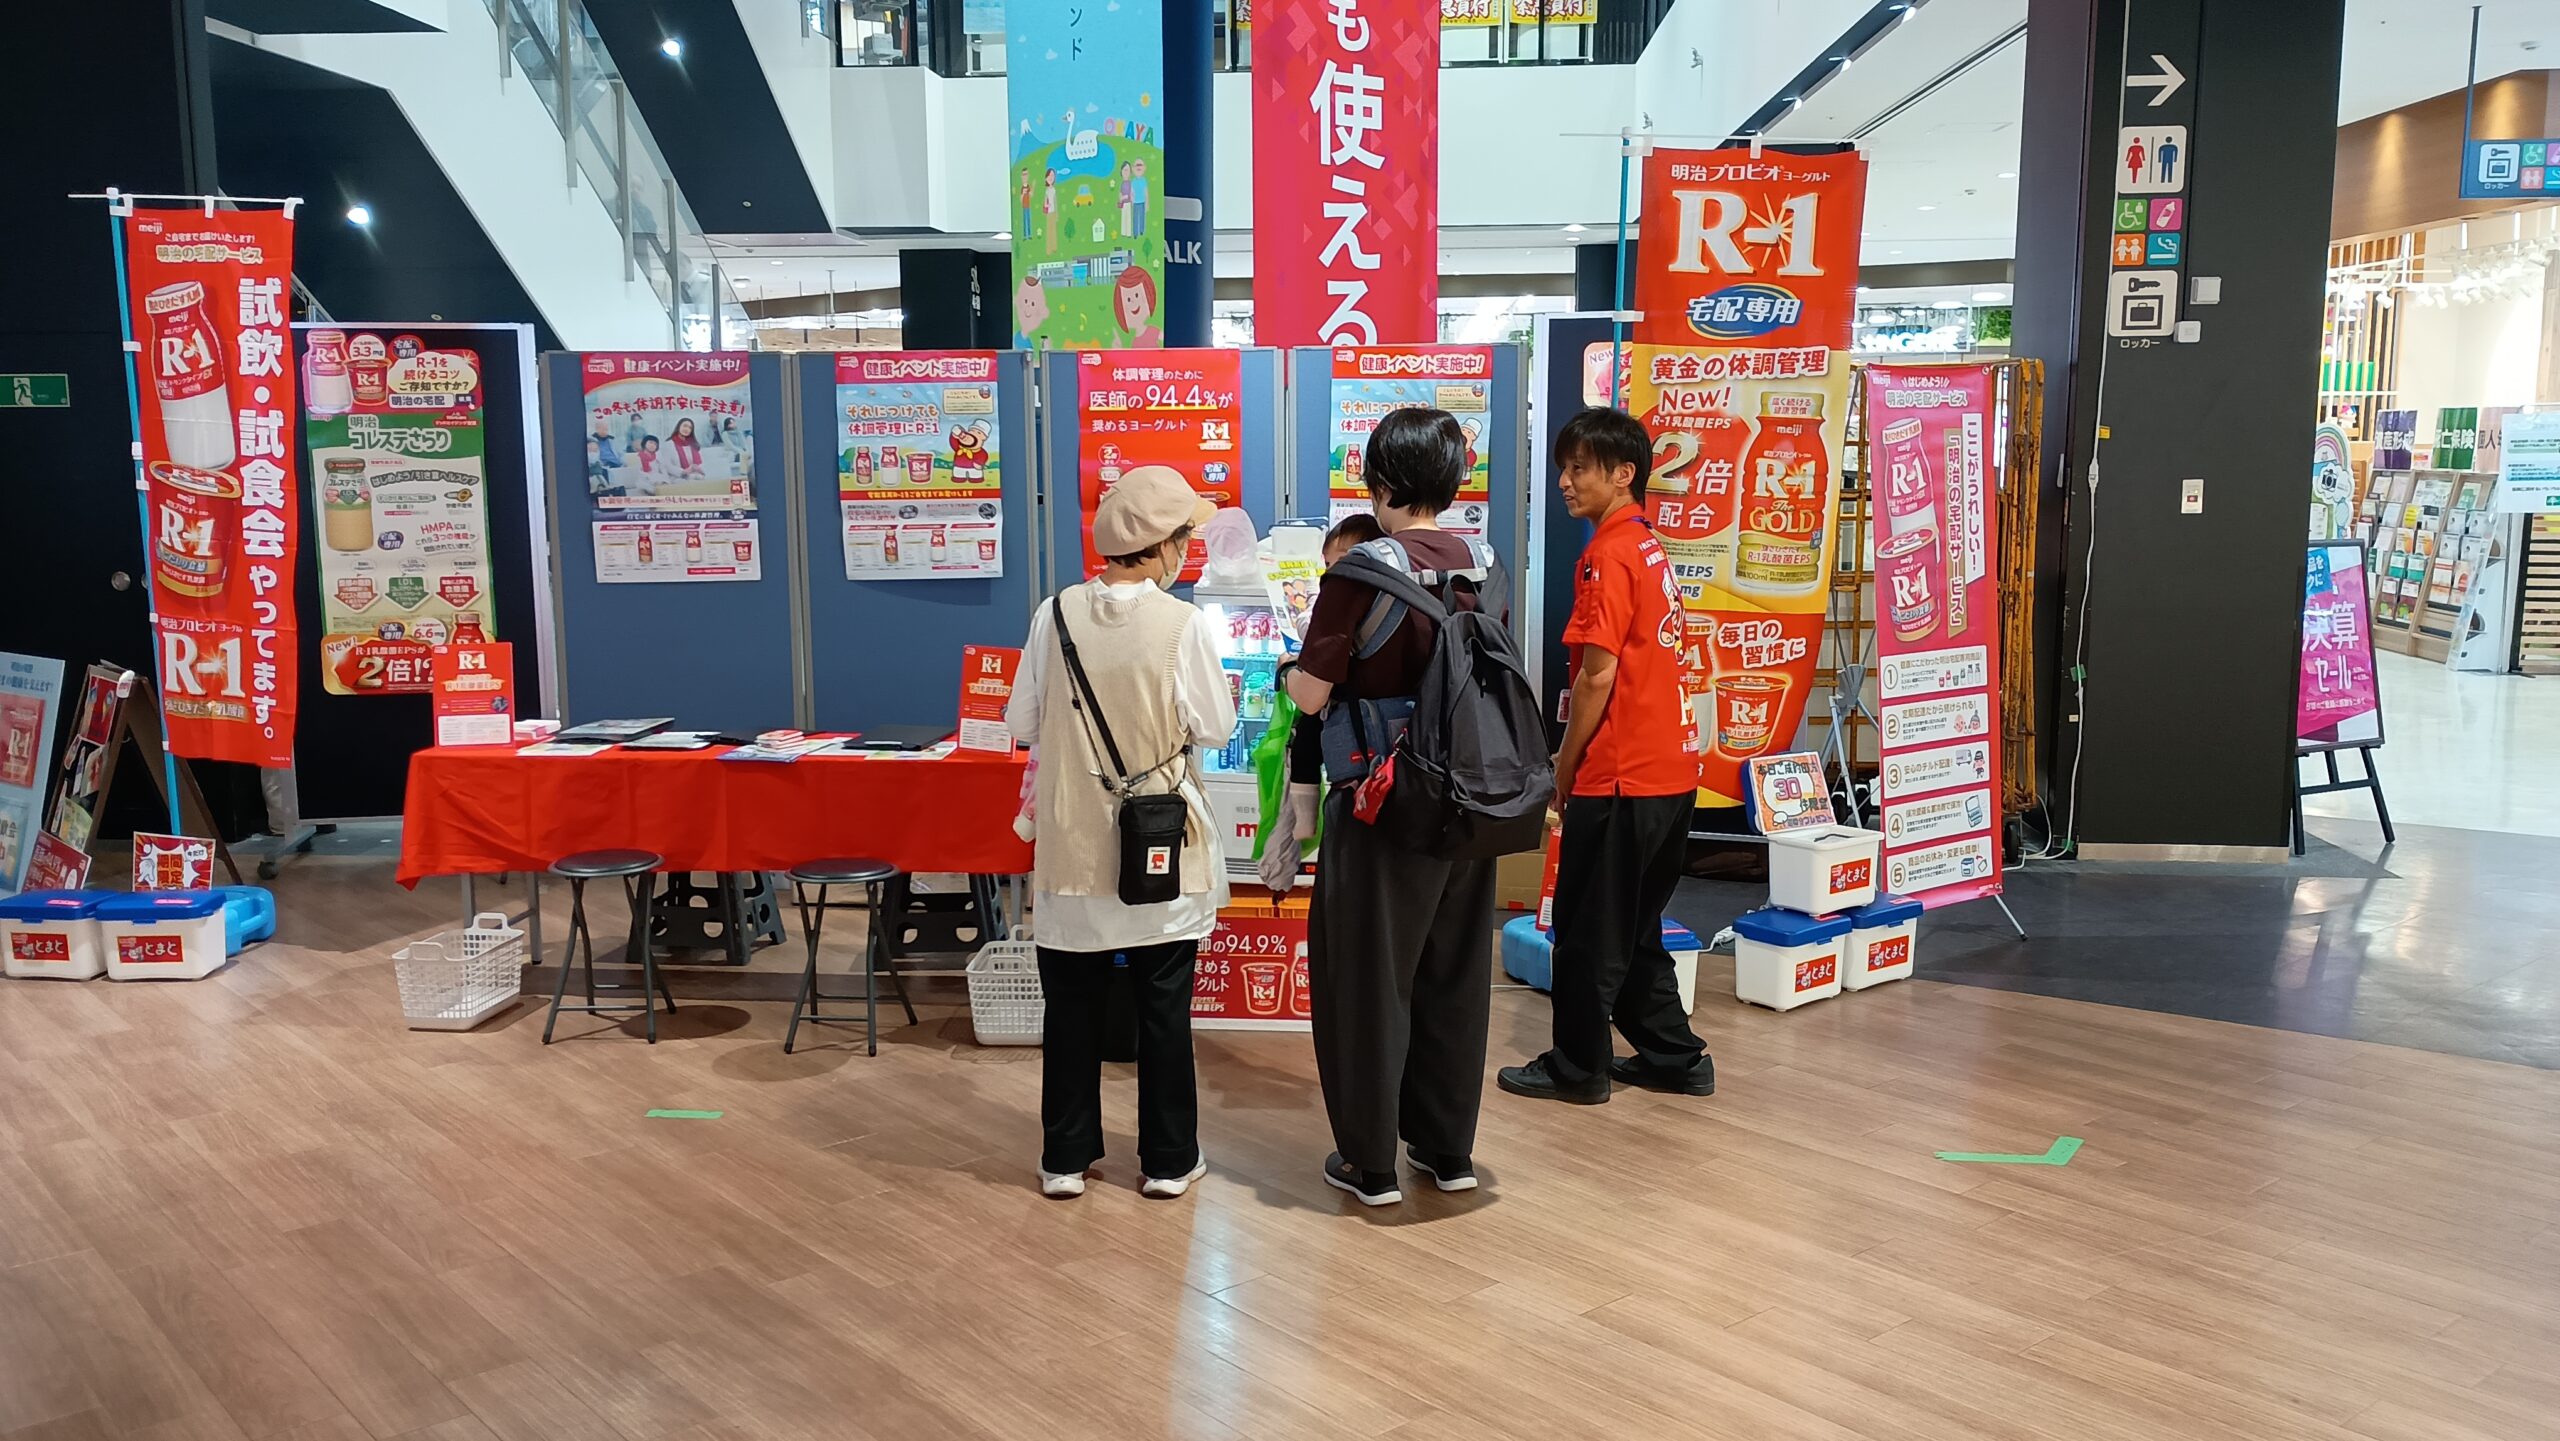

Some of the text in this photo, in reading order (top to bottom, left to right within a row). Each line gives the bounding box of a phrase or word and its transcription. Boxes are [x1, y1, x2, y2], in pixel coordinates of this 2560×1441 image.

[1069, 8, 1083, 61] ンド
[1671, 163, 1831, 182] 明治プロビオヨーグルト
[2484, 182, 2510, 191] ロッカー
[1667, 189, 1826, 277] R-1
[157, 245, 263, 264] 明治の宅配サービス
[1687, 295, 1801, 325] 宅配専用
[160, 328, 215, 376] R-1
[2120, 338, 2161, 349] ロッカー
[315, 347, 342, 363] R-1
[416, 357, 448, 369] R-1を
[624, 358, 741, 374] 健康イベント実施中!
[865, 361, 988, 377] 健康イベント実施中!
[1361, 356, 1485, 373] 健康イベント実施中!
[1653, 348, 1826, 381] 黄金の体調管理
[356, 373, 380, 386] R-1
[404, 370, 460, 380] 続けるコツ
[1112, 368, 1204, 381] 体調管理のために
[399, 381, 469, 392] ご存知ですか?
[391, 396, 446, 407] 明治の宅配
[1089, 384, 1234, 409] 医師の94.4%が
[1661, 387, 1732, 412] New!
[1886, 390, 1968, 407] 明治の宅配サービス
[593, 395, 746, 420] この冬も、体調不安に要注意!
[847, 405, 938, 418] それにつけても
[350, 416, 377, 428] 明治
[848, 421, 940, 435] 体調管理にR-1
[1092, 419, 1188, 433] 奨めるヨーグルト
[1201, 422, 1231, 440] R-1
[1651, 415, 1732, 429] R-1乳酸菌EPS
[1776, 424, 1803, 437] meiji
[350, 430, 449, 451] コレステさらり
[1752, 457, 1816, 499] R-1
[1891, 456, 1927, 497] R-1
[1965, 421, 1981, 572] ここがうれしい!
[1657, 501, 1716, 530] 配合
[1749, 506, 1816, 533] GOLD
[160, 504, 215, 556] R-1
[1947, 434, 1964, 627] 「明治の宅配サービス」
[1747, 551, 1812, 564] R-1乳酸菌EPS
[1891, 565, 1931, 608] R-1
[1721, 622, 1779, 644] 毎日の
[326, 637, 357, 654] New!
[1745, 641, 1805, 666] 習慣に
[162, 631, 246, 698] R-1
[458, 653, 487, 670] R-1
[981, 656, 1002, 674] R-1
[2315, 655, 2352, 693] セール
[1729, 699, 1770, 725] R-1
[1773, 777, 1802, 801] 30
[1846, 866, 1867, 883] とまと
[36, 940, 64, 954] とまと
[145, 941, 177, 956] とまと
[1884, 942, 1906, 960] とまと
[1811, 961, 1833, 980] とまと
[1253, 985, 1276, 999] R-1
